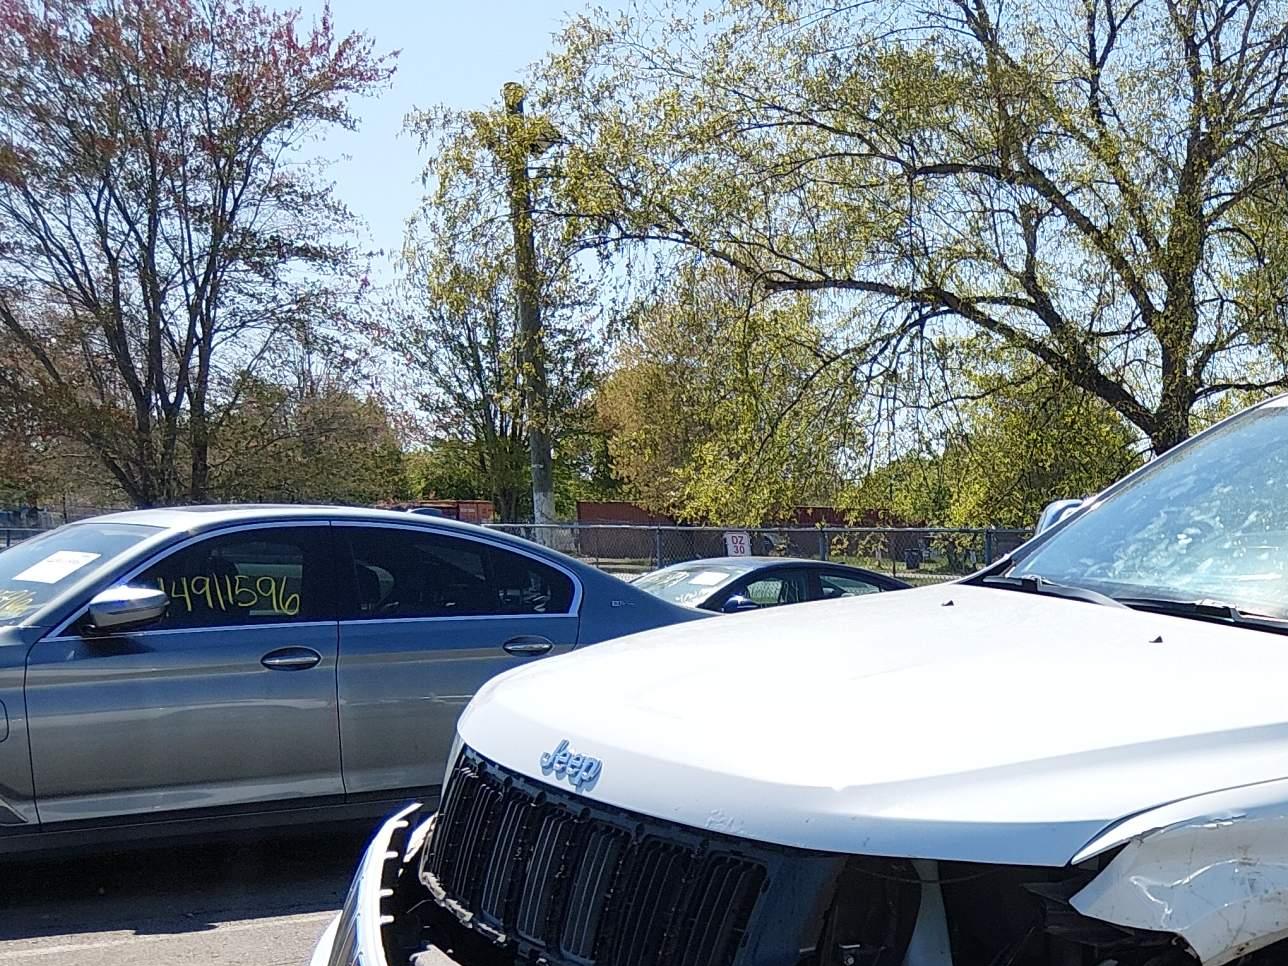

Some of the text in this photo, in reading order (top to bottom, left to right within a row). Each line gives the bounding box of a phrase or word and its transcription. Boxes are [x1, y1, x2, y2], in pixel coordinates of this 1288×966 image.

[731, 535, 745, 545] DZ
[733, 545, 745, 554] 30
[540, 738, 603, 788] Jeep
